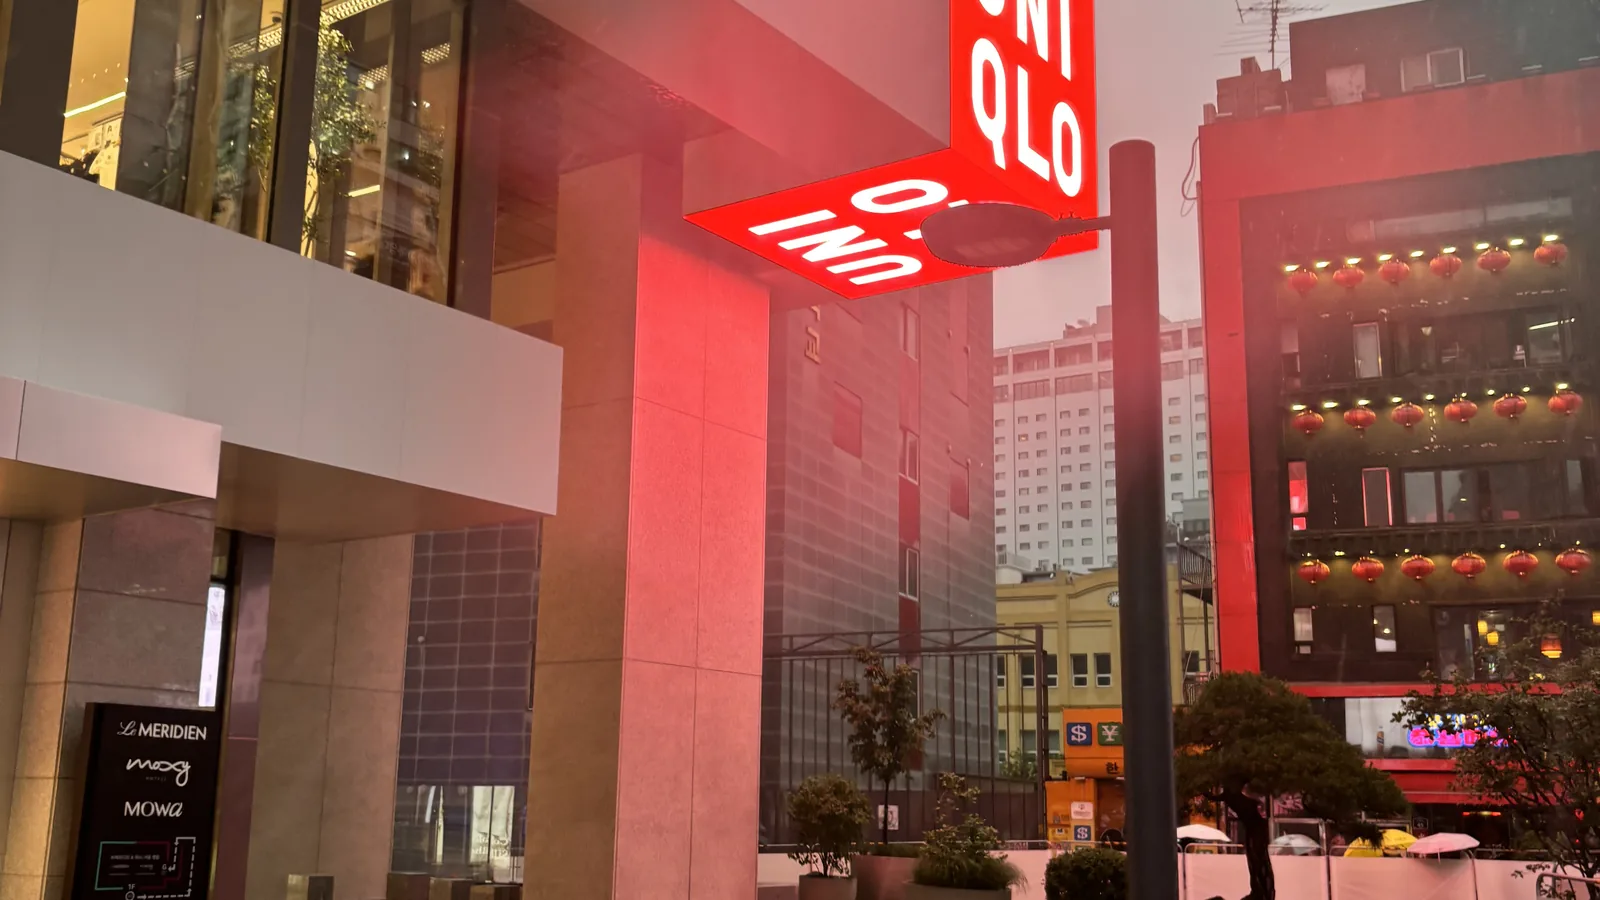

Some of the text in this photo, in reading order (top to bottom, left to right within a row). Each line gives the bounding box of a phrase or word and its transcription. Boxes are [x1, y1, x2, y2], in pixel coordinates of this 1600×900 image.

[978, 0, 1071, 81] NI
[972, 38, 1081, 197] QLO
[748, 209, 922, 285] UNI
[117, 720, 207, 740] Le MERIDIEN
[1071, 725, 1087, 742] $
